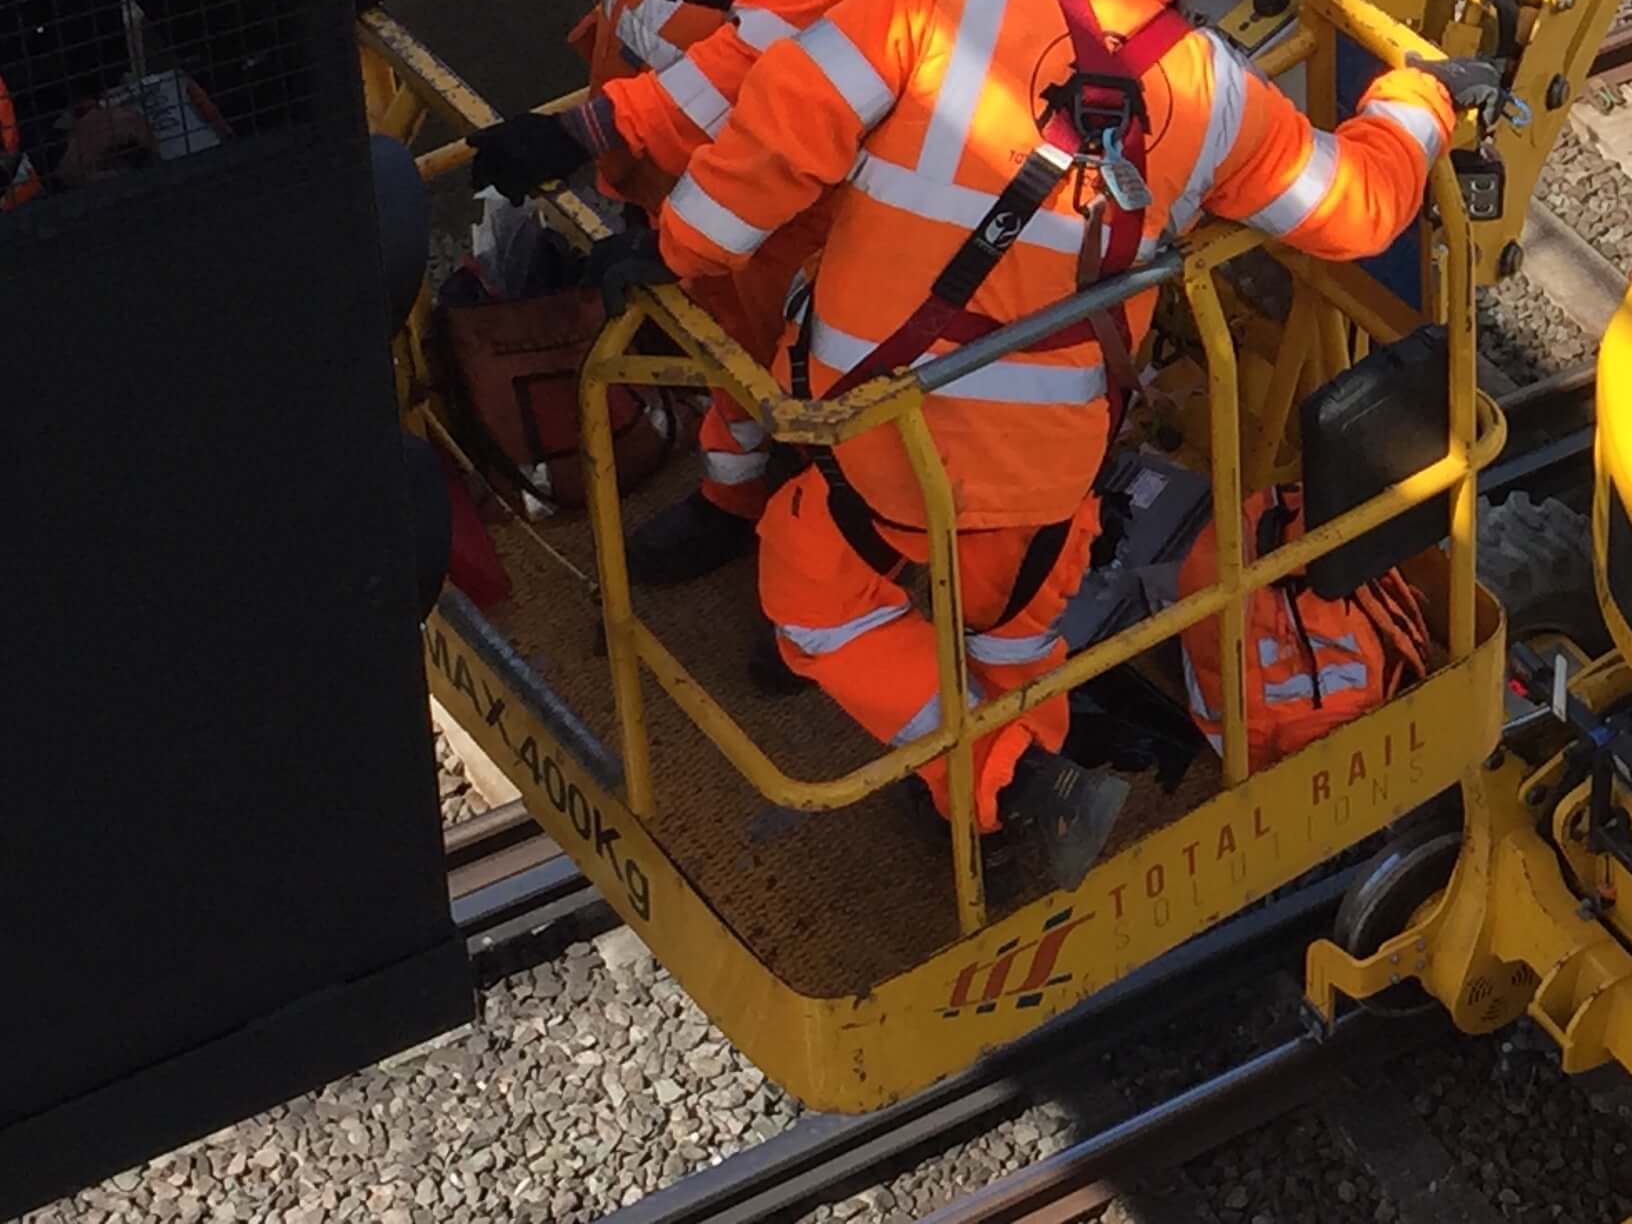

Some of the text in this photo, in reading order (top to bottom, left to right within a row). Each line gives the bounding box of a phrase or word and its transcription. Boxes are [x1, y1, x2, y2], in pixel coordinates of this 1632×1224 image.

[518, 736, 650, 922] 400Kg
[1108, 720, 1426, 918] TOTAL RAIL
[1113, 757, 1425, 952] SOLUTIONS
